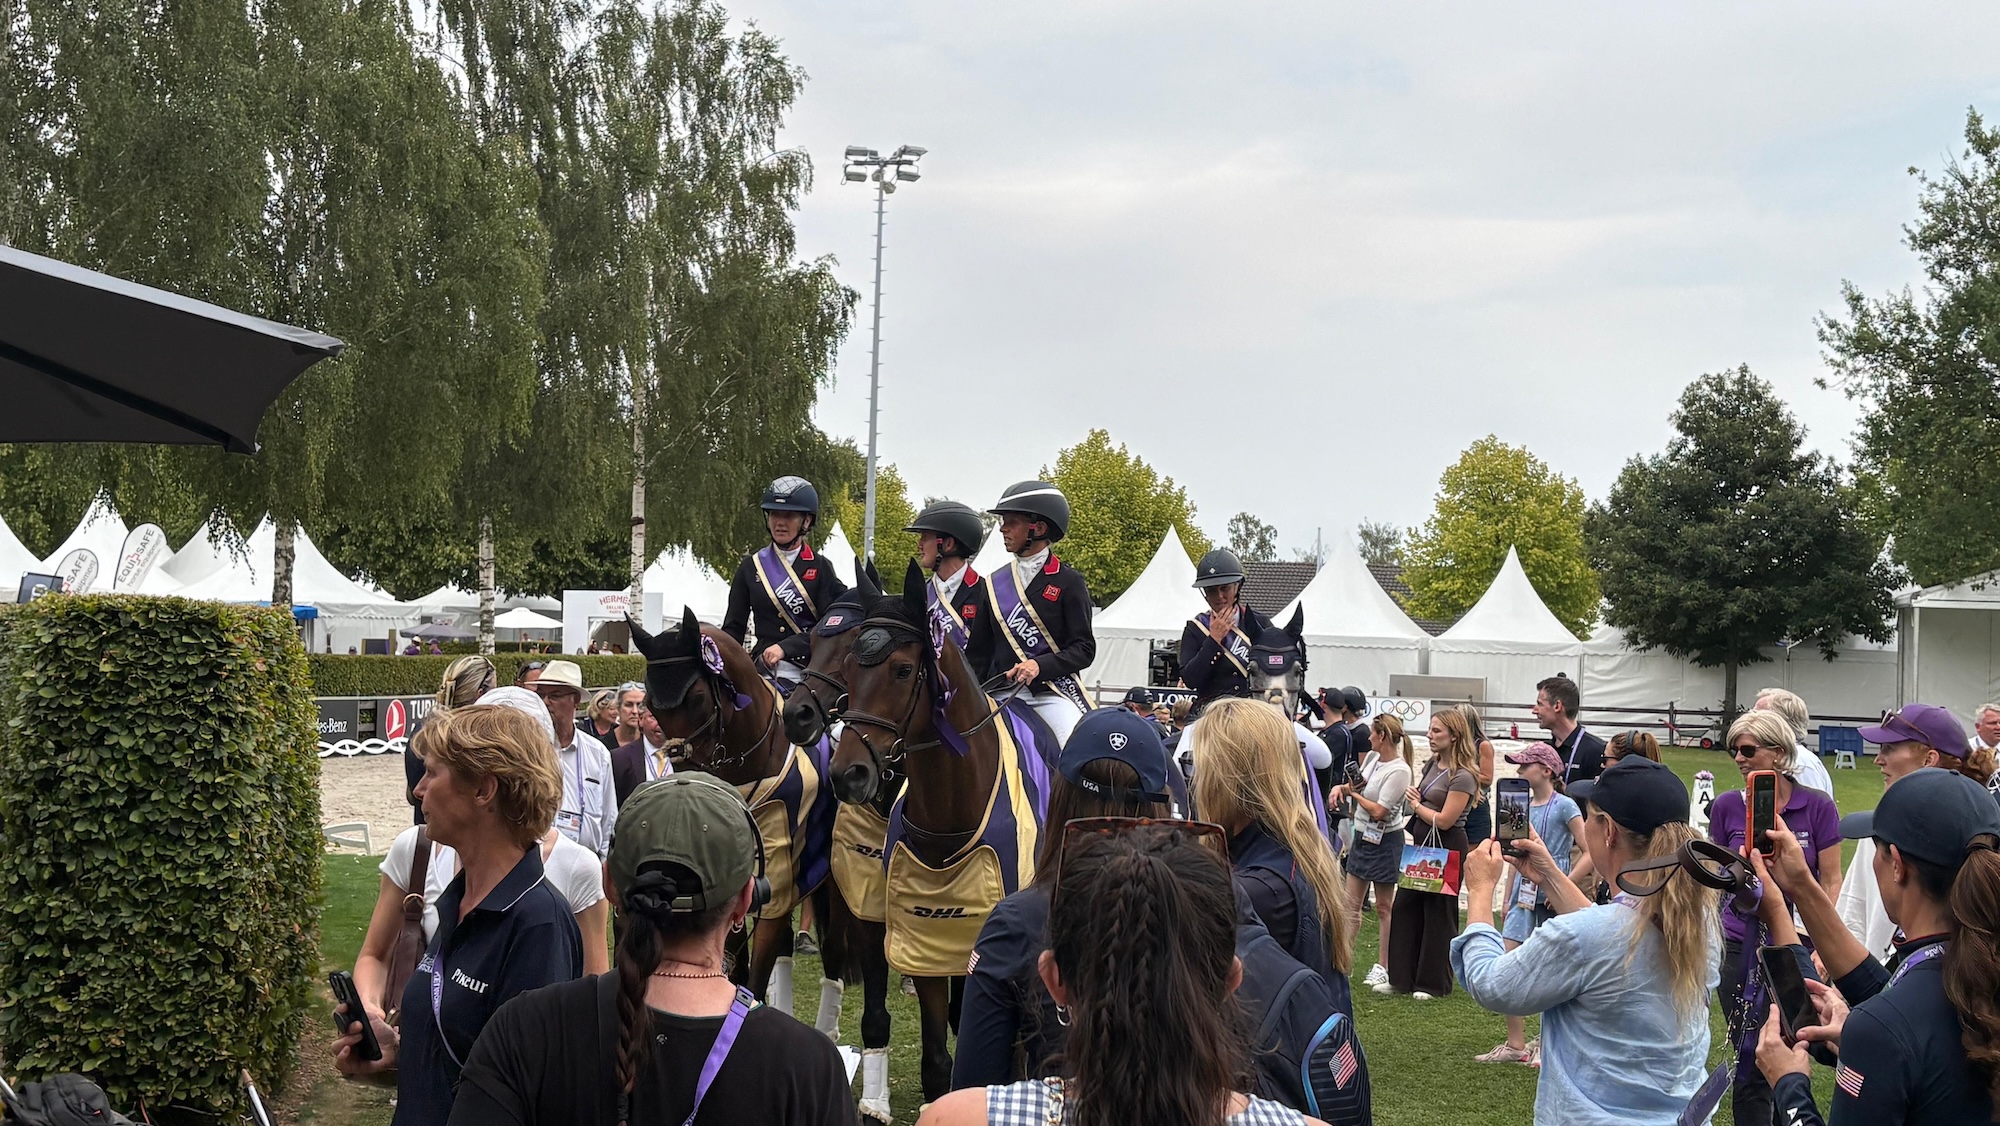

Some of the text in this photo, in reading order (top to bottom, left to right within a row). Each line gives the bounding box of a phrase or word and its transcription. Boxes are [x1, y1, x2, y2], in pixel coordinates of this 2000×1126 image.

[117, 559, 137, 583] EQUI
[135, 528, 155, 554] SAFE
[127, 567, 143, 587] horse
[140, 533, 163, 568] equipment
[66, 552, 88, 583] SAFE
[1082, 780, 1100, 793] USA
[1698, 790, 1711, 804] A
[912, 905, 969, 918] DHL
